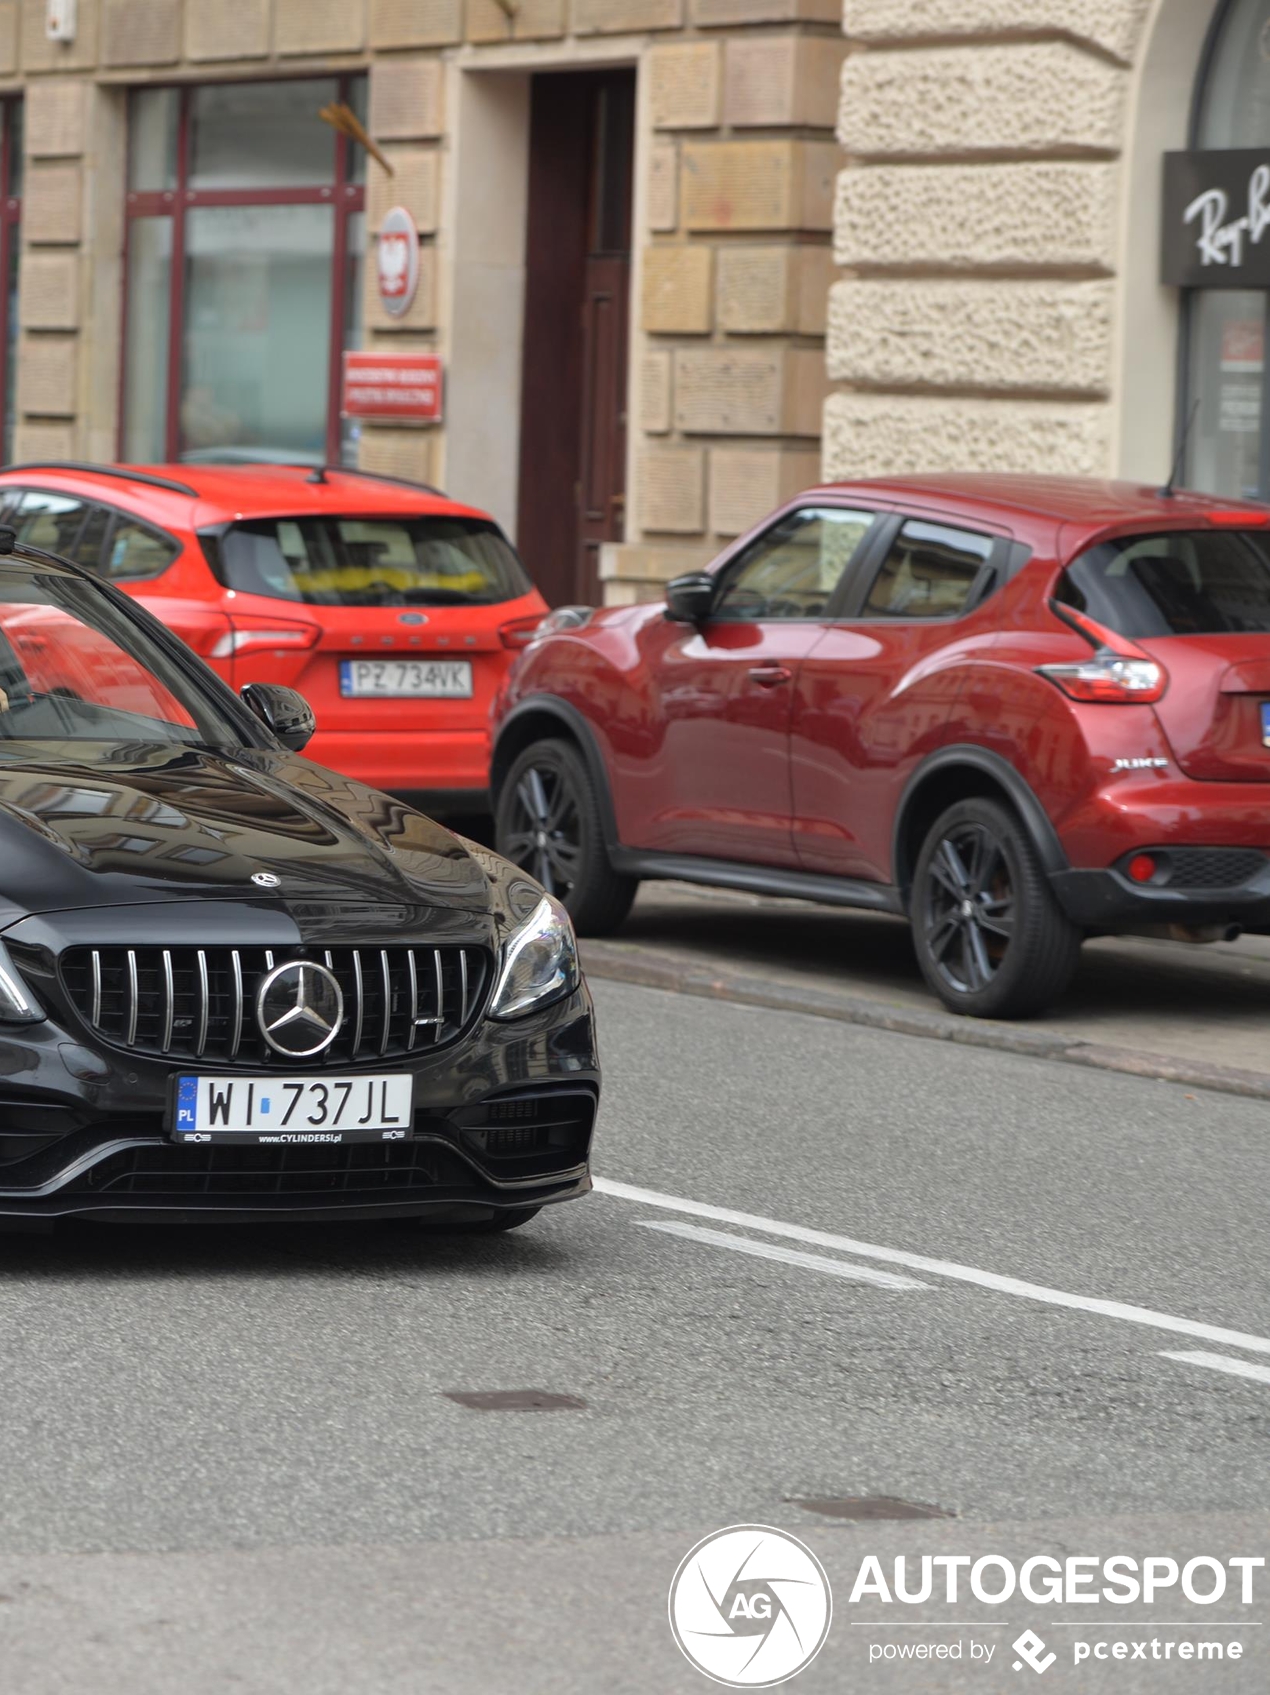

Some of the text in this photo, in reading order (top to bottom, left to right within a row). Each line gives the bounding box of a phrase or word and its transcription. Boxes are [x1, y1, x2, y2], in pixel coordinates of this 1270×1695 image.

[1109, 758, 1168, 773] JUKE
[209, 1081, 399, 1126] WI 737JL
[179, 1109, 194, 1122] PL
